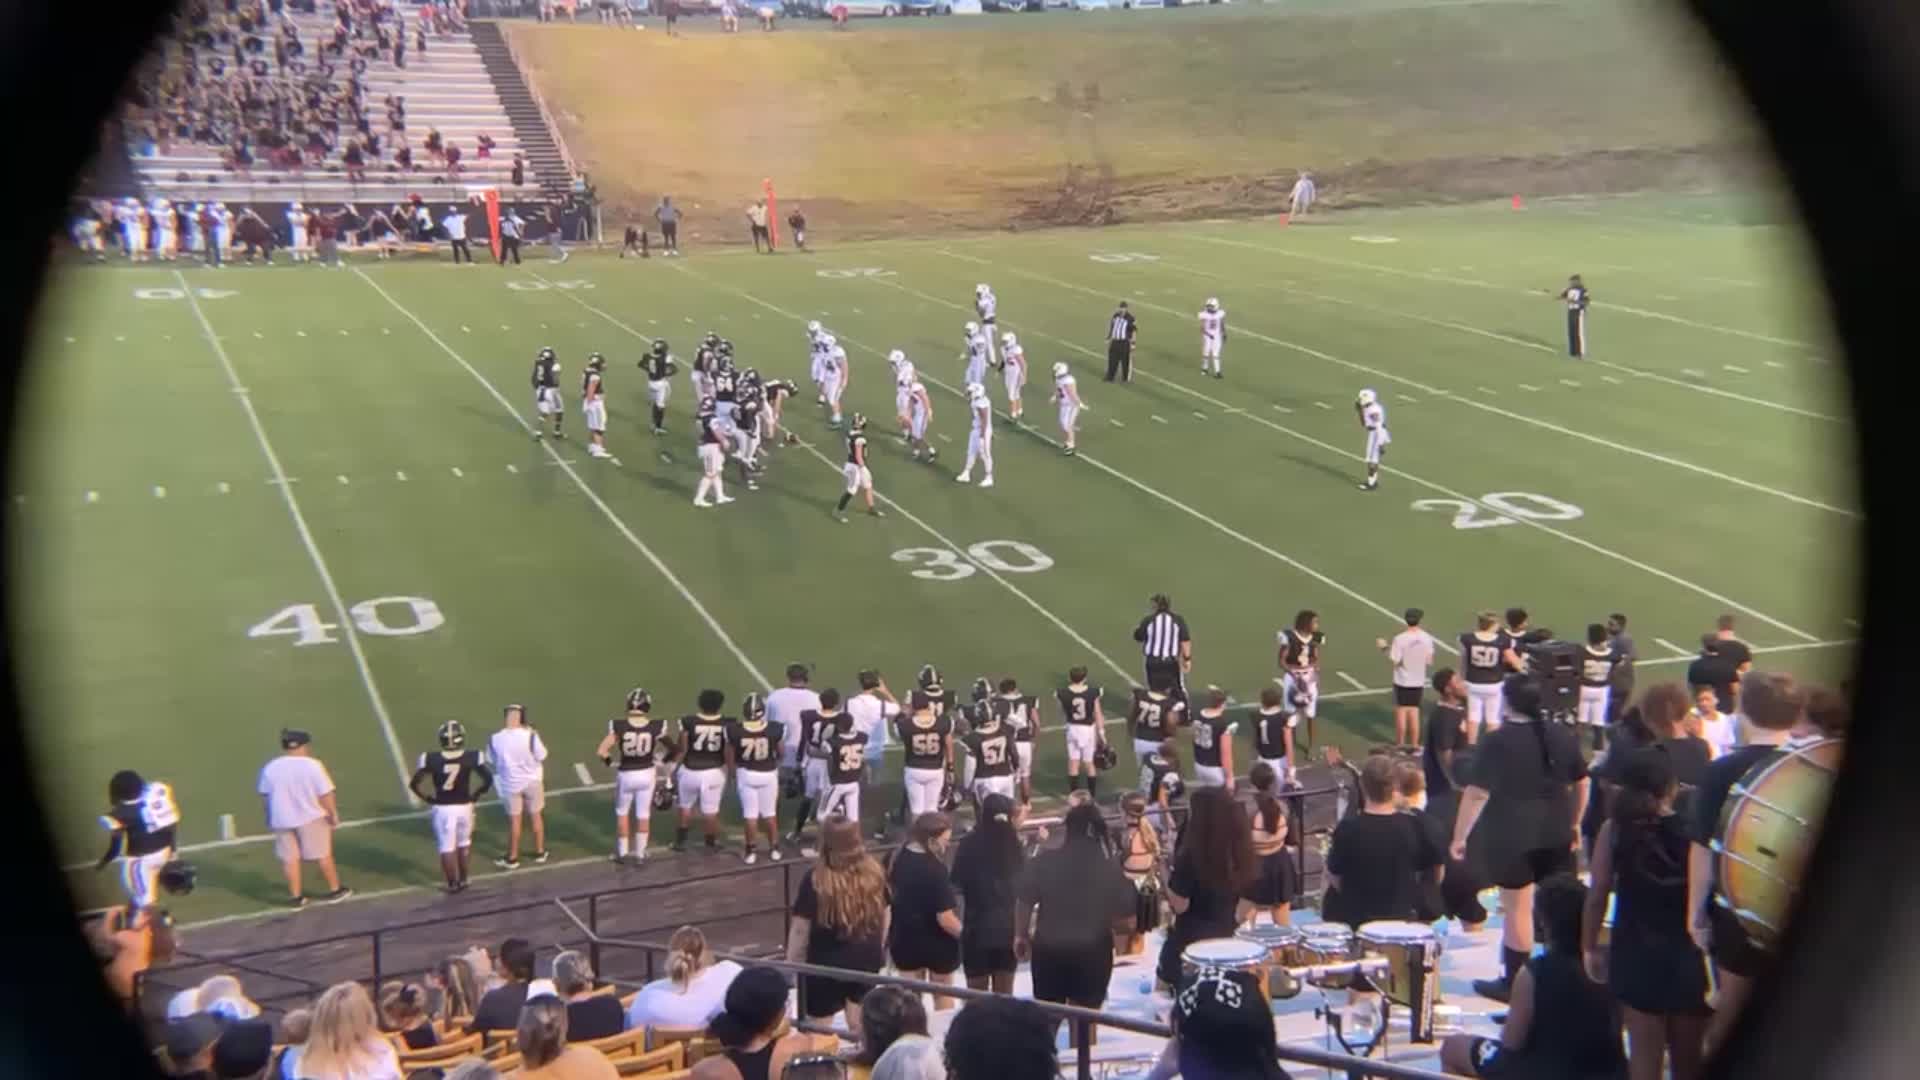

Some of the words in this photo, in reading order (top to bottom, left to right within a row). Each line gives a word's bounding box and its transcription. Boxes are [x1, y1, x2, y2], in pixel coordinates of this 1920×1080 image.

[1410, 491, 1584, 529] 20
[890, 540, 1054, 580] 30
[248, 596, 446, 646] 40
[1469, 644, 1500, 668] 50
[1071, 697, 1086, 721] 3
[1138, 701, 1162, 728] 72
[622, 730, 652, 757] 20
[693, 724, 724, 752] 75
[912, 732, 941, 756] 56
[1259, 719, 1270, 745] 1
[740, 736, 770, 762] 78
[838, 744, 866, 771] 35
[980, 735, 1008, 766] 57
[442, 763, 461, 791] 7
